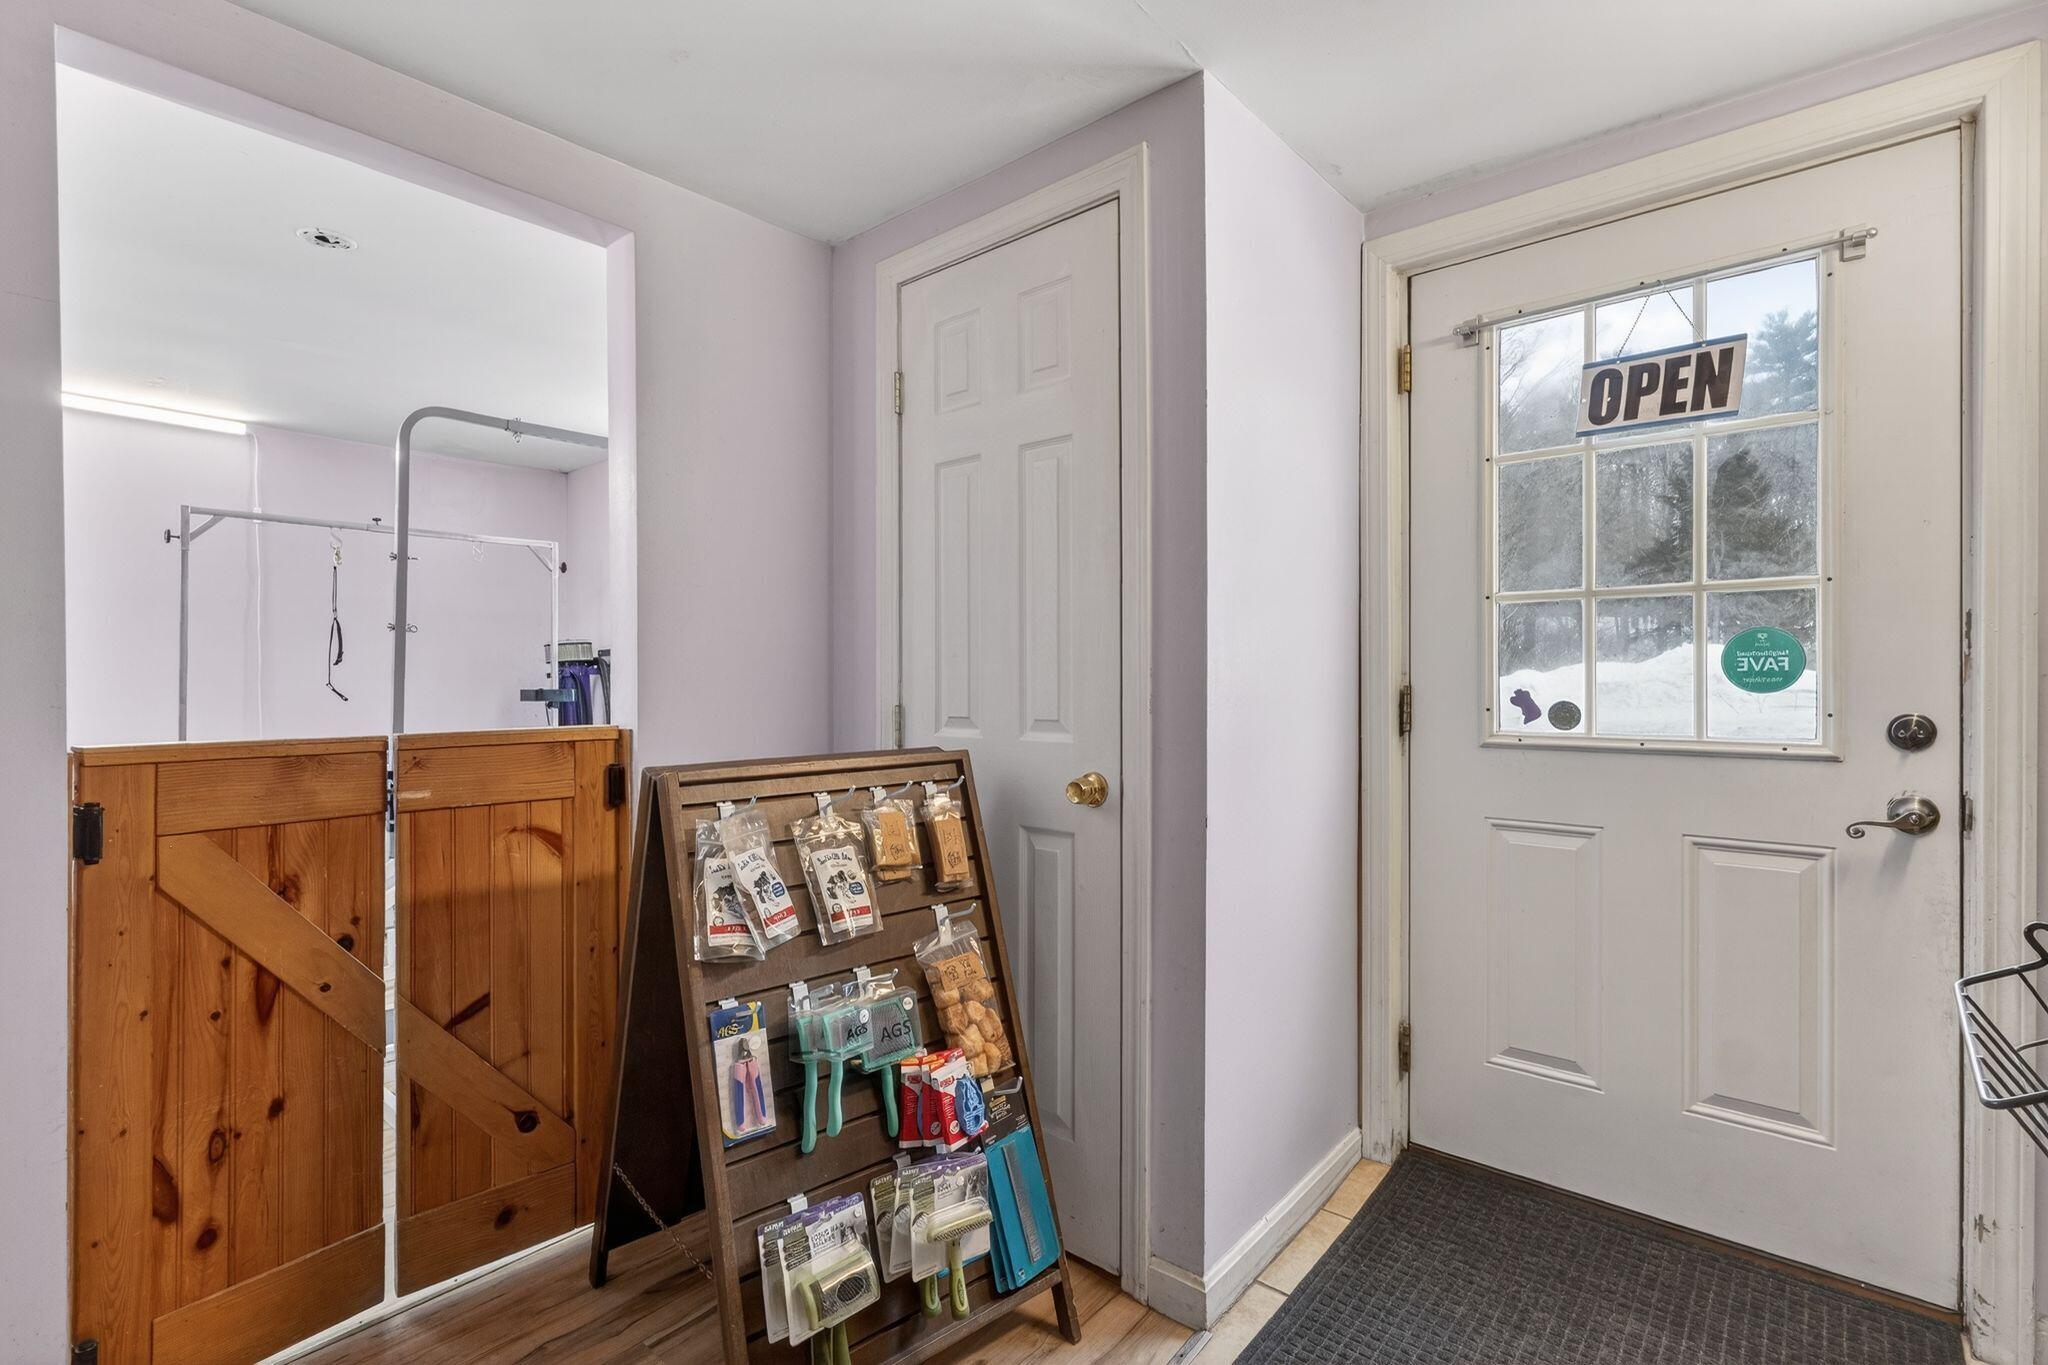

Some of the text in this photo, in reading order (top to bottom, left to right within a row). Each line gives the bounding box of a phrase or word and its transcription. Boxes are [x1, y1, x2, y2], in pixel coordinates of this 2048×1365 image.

[1588, 347, 1734, 426] OPEN
[847, 1023, 868, 1041] AGS
[881, 1019, 912, 1042] AGS
